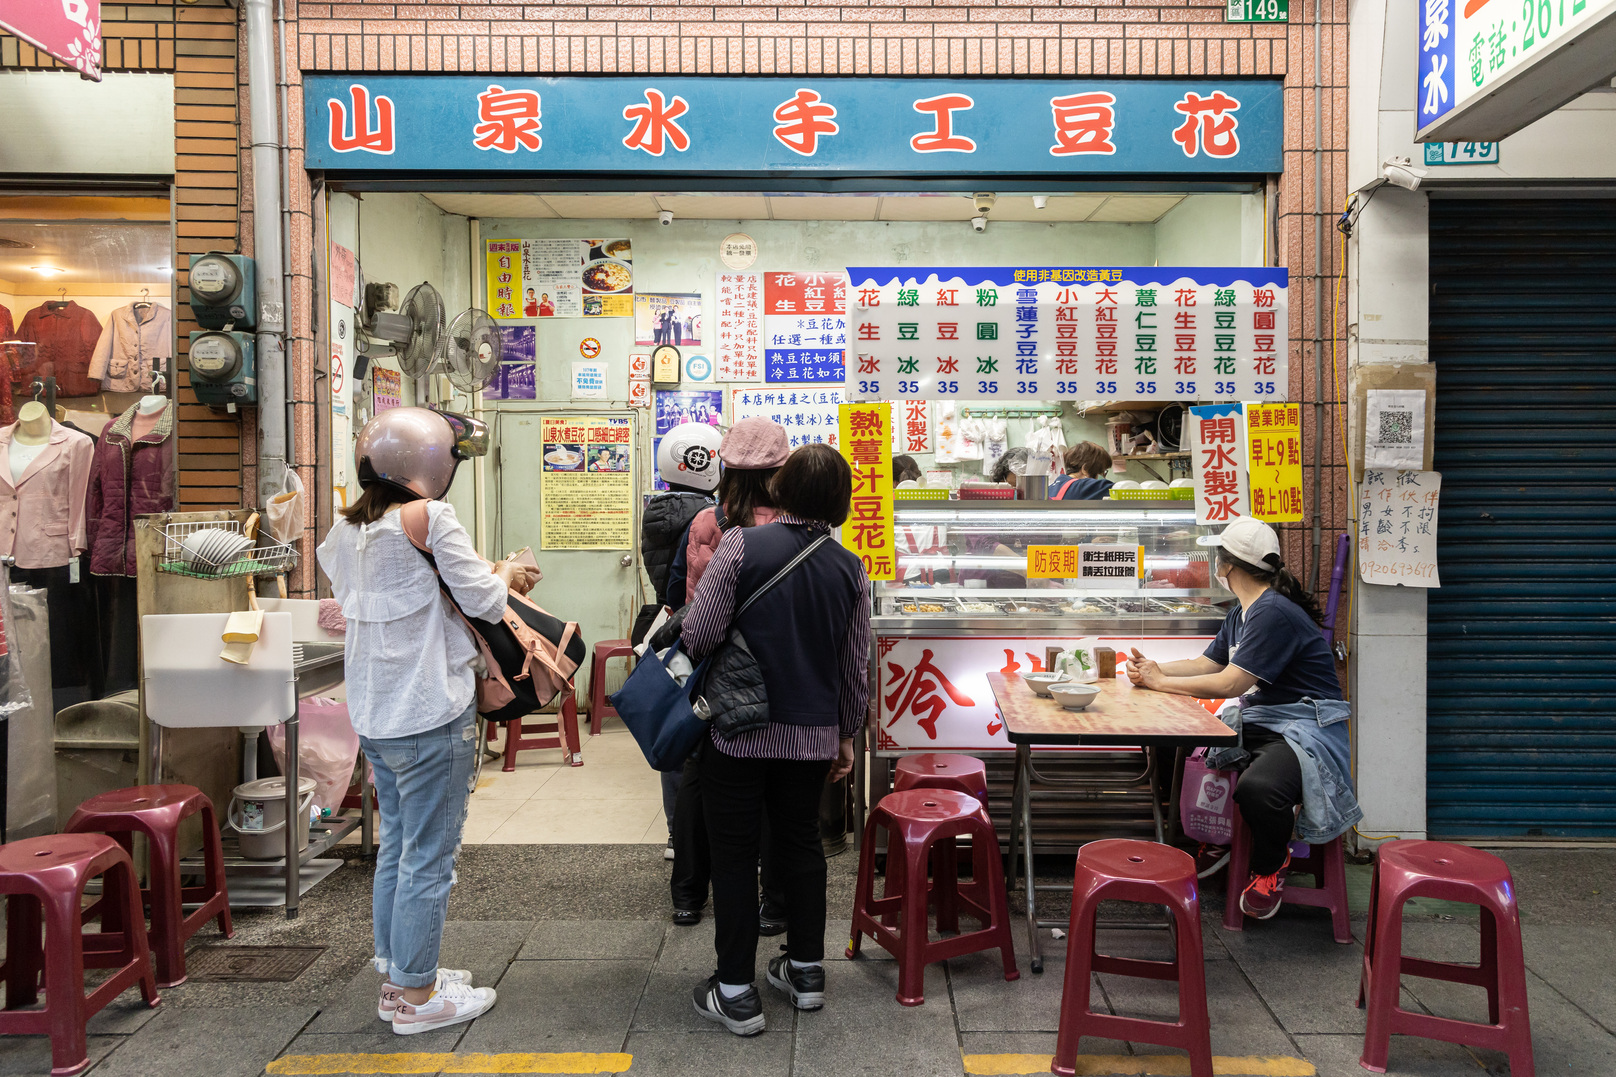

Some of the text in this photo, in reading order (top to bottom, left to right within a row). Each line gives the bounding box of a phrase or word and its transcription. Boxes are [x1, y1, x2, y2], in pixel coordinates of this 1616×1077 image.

[328, 84, 1240, 158] 山泉水手工豆花
[497, 256, 515, 317] 自由時報
[1014, 269, 1123, 282] 使用非基因改造黃豆
[804, 274, 825, 312] 小紅豆
[858, 289, 880, 374] 花生冰
[897, 289, 919, 374] 綠豆冰
[936, 289, 959, 374] 紅豆冰
[976, 289, 998, 374] 粉圓冰
[1015, 289, 1038, 374] 雪蓮子豆花
[1055, 289, 1078, 374] 小紅豆豆花
[1095, 289, 1118, 374] 大紅豆豆花
[1135, 289, 1157, 374] 薏仁豆花
[1174, 289, 1197, 374] 花生豆花
[1213, 289, 1236, 374] 綠豆豆花
[1253, 289, 1275, 374] 粉圓豆花
[858, 381, 879, 393] 35
[898, 381, 919, 393] 35
[938, 381, 959, 393] 35
[978, 381, 998, 393] 35
[1016, 381, 1038, 393] 35
[1056, 381, 1077, 393] 35
[1096, 381, 1117, 393] 35
[1136, 381, 1156, 393] 35
[1175, 381, 1196, 393] 35
[1214, 381, 1236, 393] 35
[1254, 381, 1275, 393] 35
[1249, 408, 1299, 427] 營業時間
[543, 426, 585, 443] 山泉水煮豆花
[1252, 437, 1300, 467] 早上9點
[849, 410, 885, 551] 熱薑汁豆花
[1200, 418, 1241, 521] 開水製冰
[1254, 487, 1302, 516] 晚上10點
[1034, 550, 1075, 573] 防疫期
[1083, 551, 1135, 562] 衛生紙用完
[1083, 566, 1135, 577] 請丟垃圾筒
[885, 648, 976, 740] 冷
